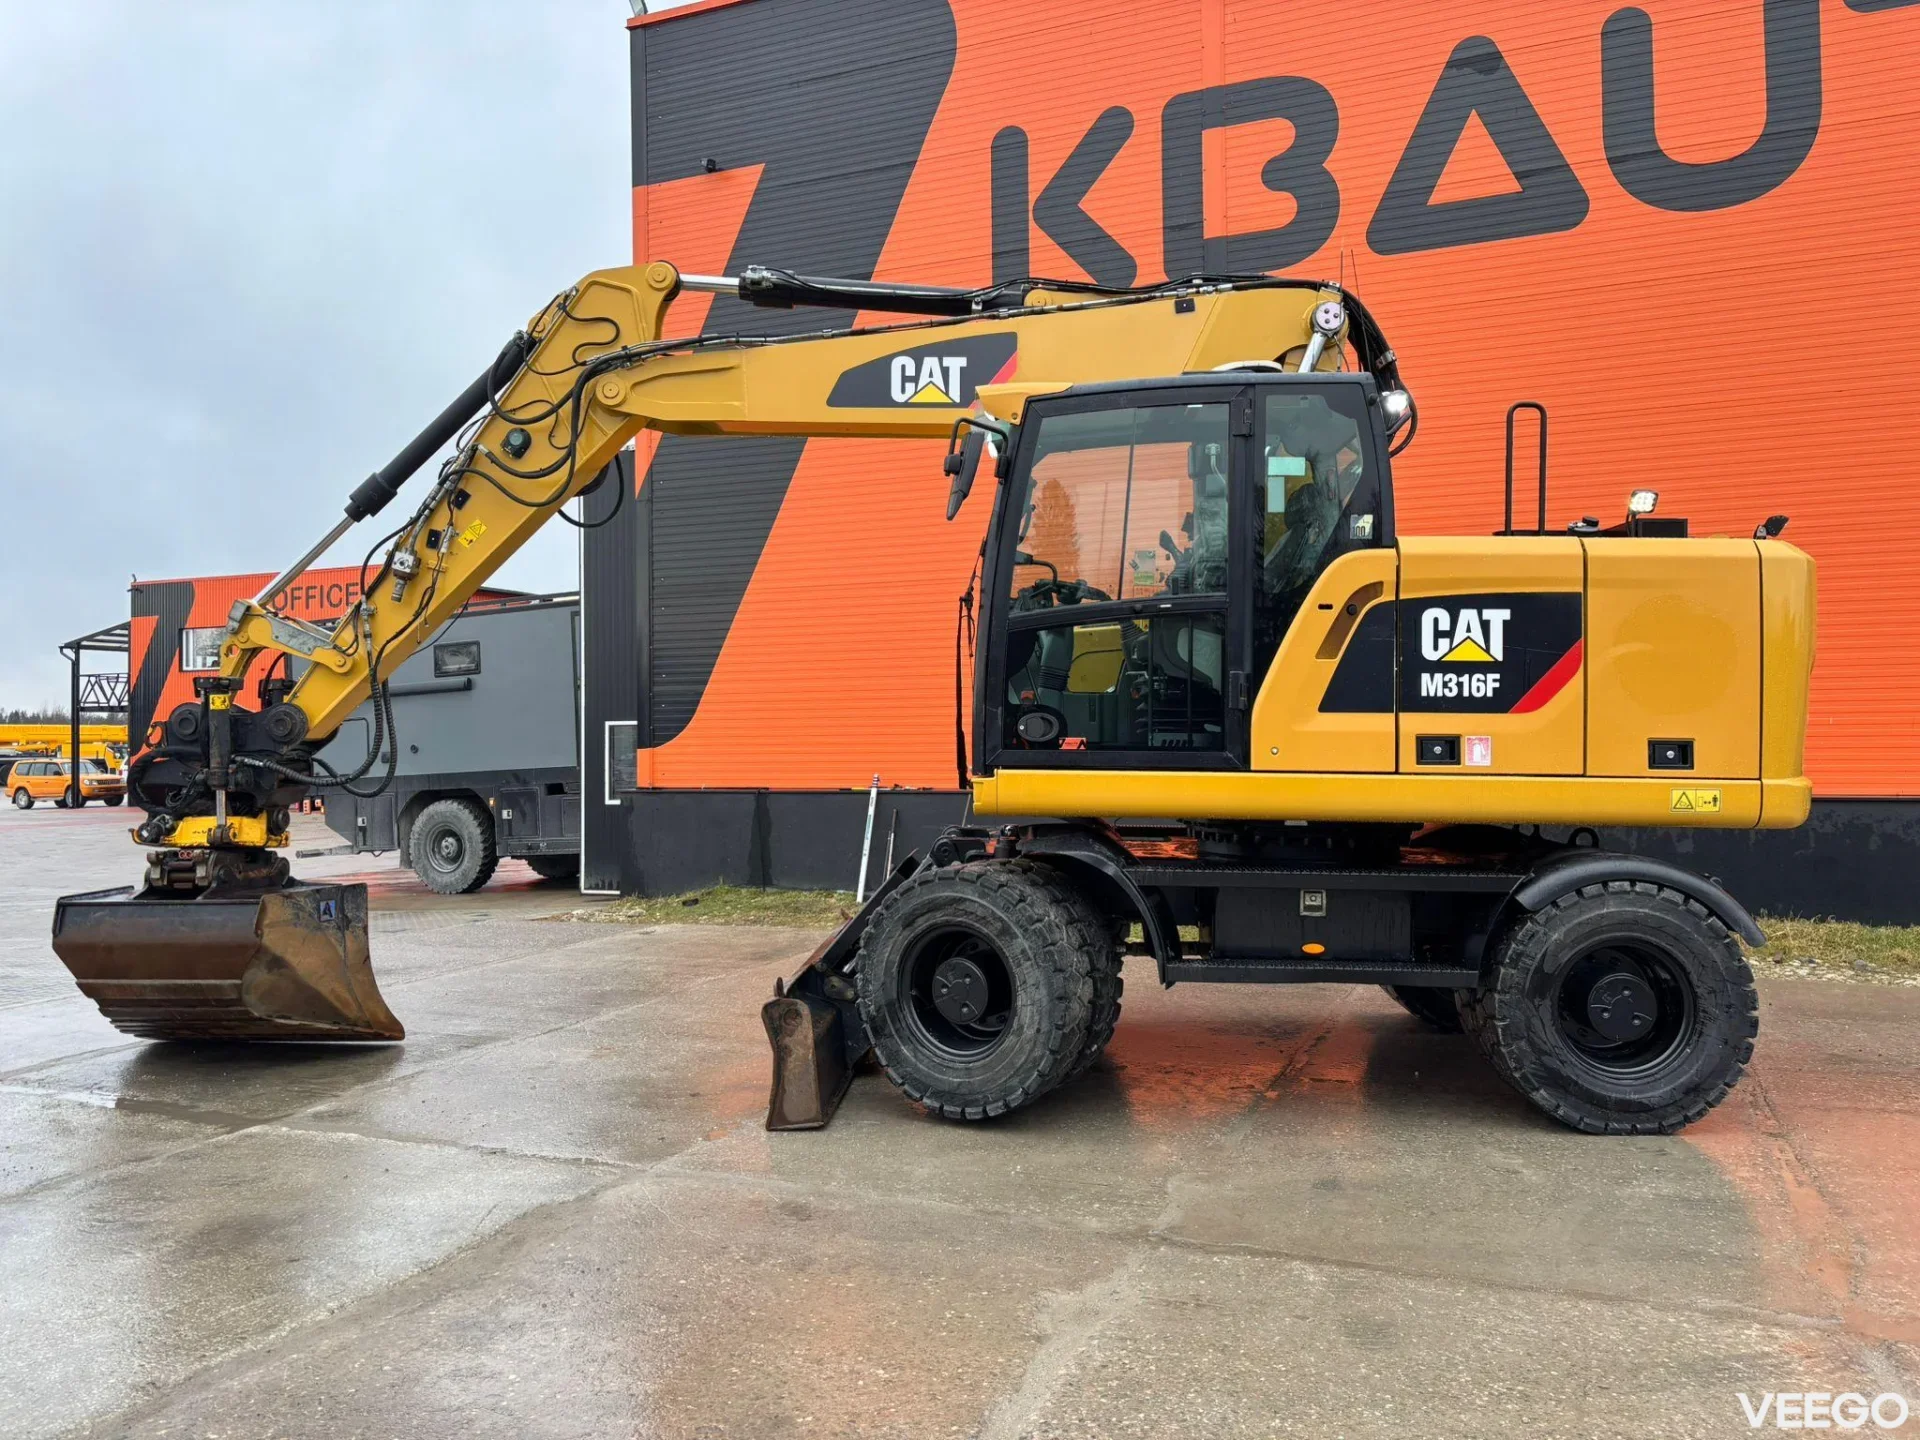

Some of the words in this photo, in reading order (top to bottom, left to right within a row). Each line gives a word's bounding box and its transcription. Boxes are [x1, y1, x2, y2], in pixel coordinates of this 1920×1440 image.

[991, 0, 1920, 290] KBAU
[891, 355, 967, 403] CAT
[272, 582, 359, 612] OFFICE
[1421, 607, 1511, 662] CAT
[1421, 672, 1501, 698] M316F
